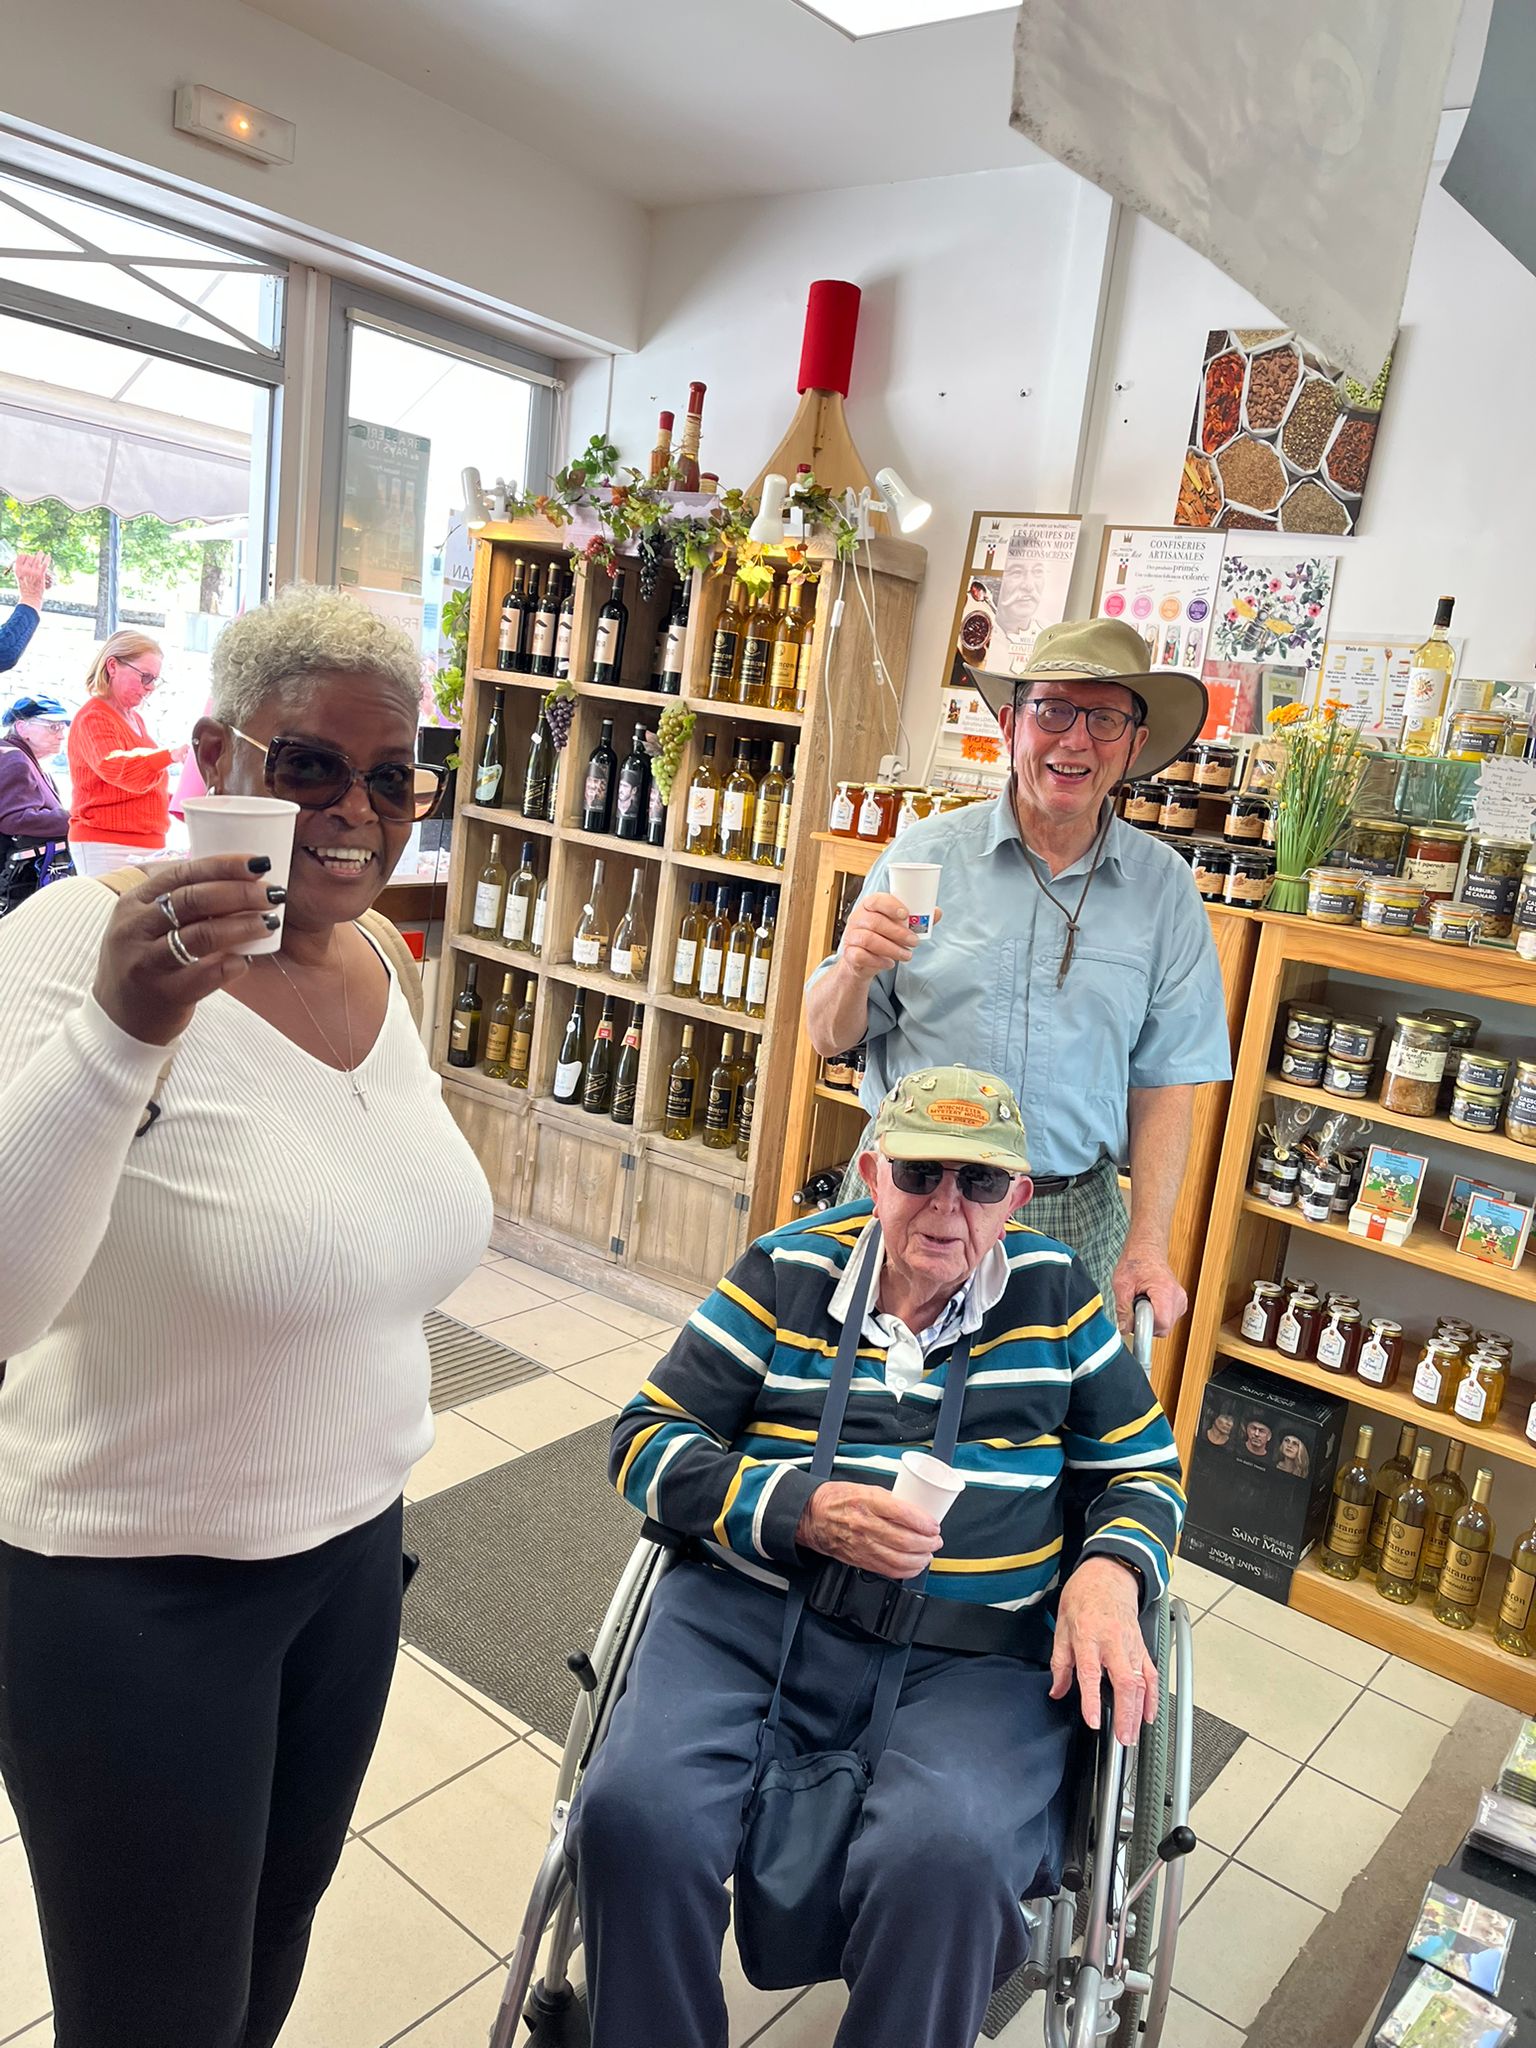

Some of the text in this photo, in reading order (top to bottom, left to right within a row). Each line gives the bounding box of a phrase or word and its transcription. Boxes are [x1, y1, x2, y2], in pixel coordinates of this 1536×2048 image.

[1012, 528, 1077, 541] LES ÉQUIPES DE
[1010, 538, 1075, 551] LA MAISON MIOT
[1150, 540, 1206, 550] CONFISERIES
[1148, 550, 1205, 560] ARTISANALES
[1173, 563, 1200, 573] primés
[1182, 571, 1210, 581] colorée
[930, 1108, 962, 1116] MYSTERY
[1239, 1384, 1297, 1408] SAINT MONT
[1231, 1526, 1295, 1561] SAINT MONT
[1286, 1543, 1295, 1552] DE
[1207, 1546, 1262, 1577] SAINT MONT
